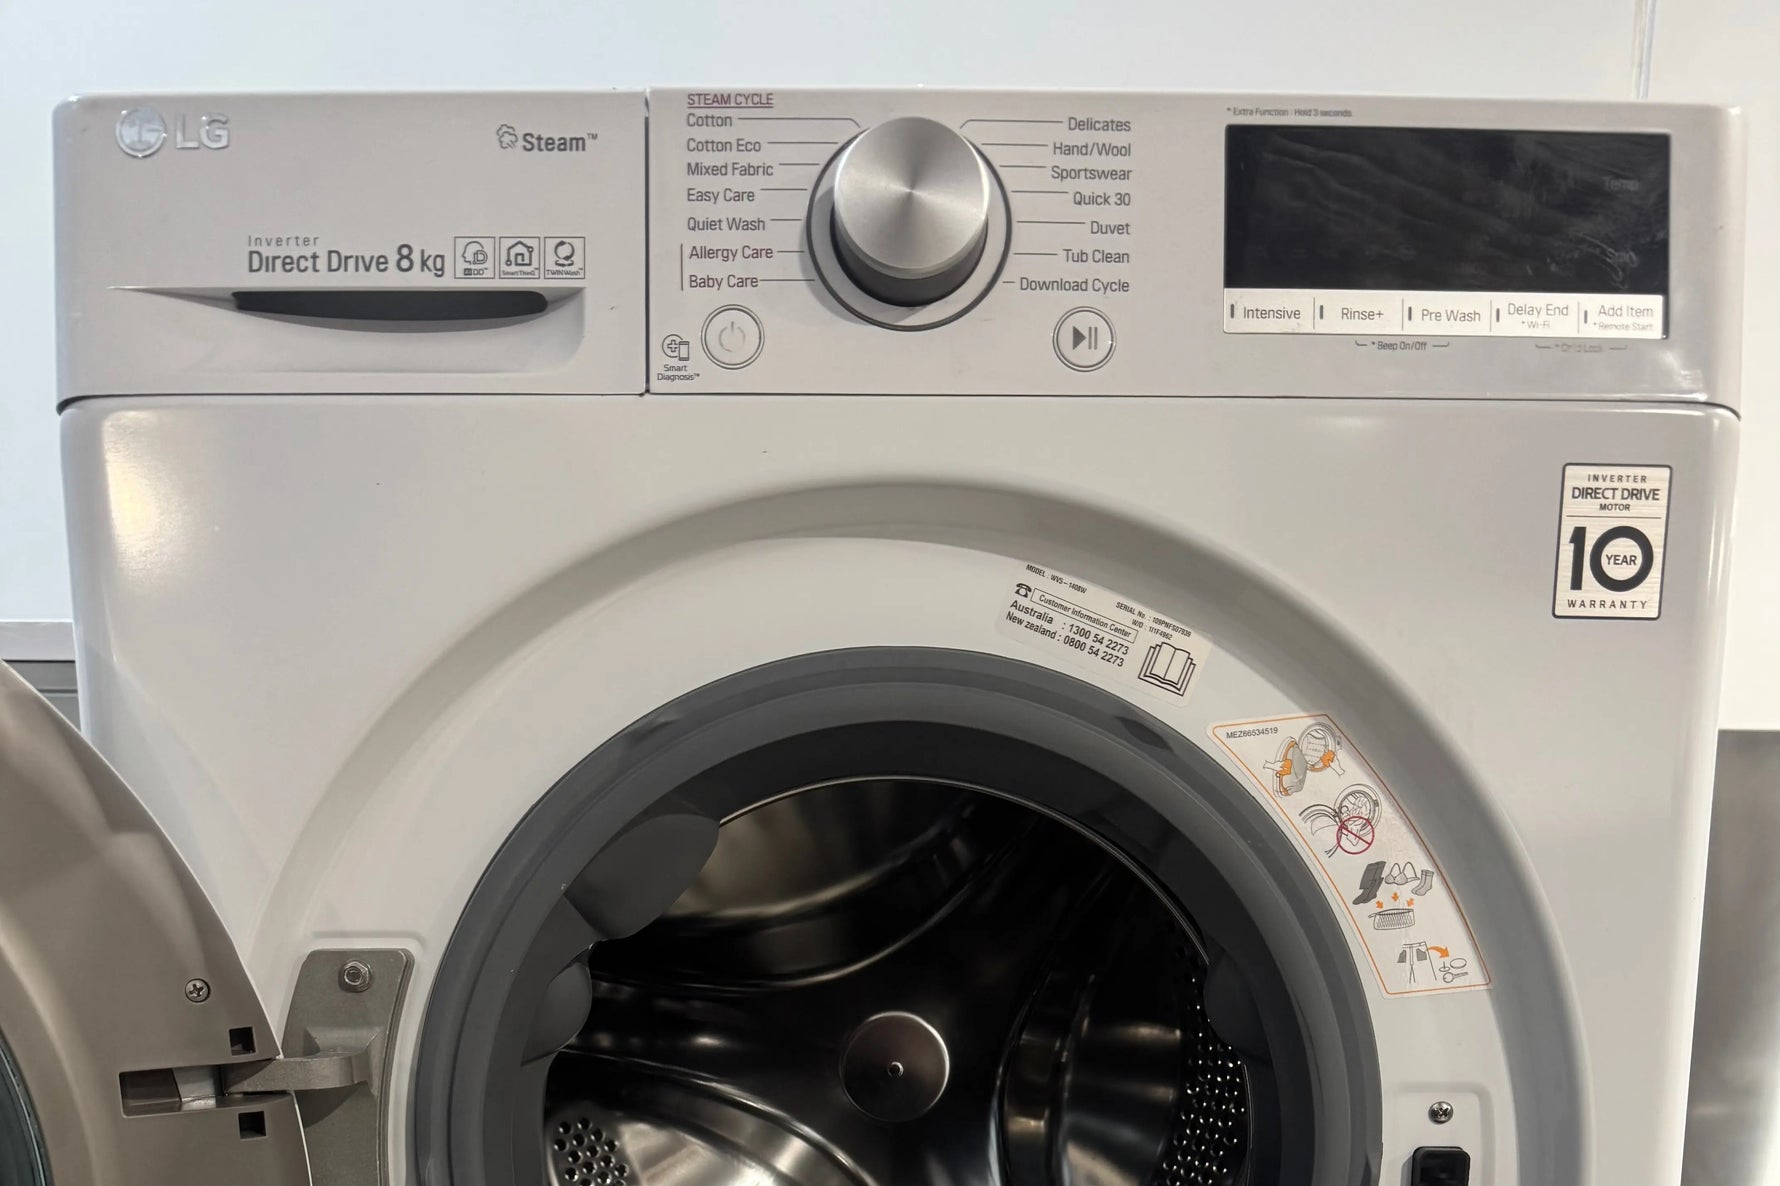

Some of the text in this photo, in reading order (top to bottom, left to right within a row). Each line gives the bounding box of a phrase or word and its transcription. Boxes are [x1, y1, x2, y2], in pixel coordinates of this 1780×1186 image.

[687, 92, 774, 105] STEAM CYCLE
[687, 113, 733, 127] Cotton
[1068, 117, 1132, 132] Delicates
[687, 138, 762, 152] Cotton Eco
[1053, 142, 1132, 157] Hand/Wool
[687, 162, 774, 176] Mixed Fabric
[1051, 165, 1133, 183] Sportswear
[687, 188, 755, 205] Easy Care
[1073, 191, 1132, 206] Quick 30
[687, 217, 766, 232] Quiet Wash
[1090, 220, 1131, 235] Duvet
[248, 235, 320, 247] Inverter
[396, 244, 415, 273] 8
[420, 249, 446, 277] kg
[689, 245, 774, 262] Allergy Care
[1062, 249, 1130, 263] Tub Clean
[689, 274, 759, 291] Baby Care
[1020, 277, 1130, 295] Download Cycle
[1243, 306, 1301, 319] Intensive
[1341, 307, 1384, 320] Rinse+
[1421, 309, 1481, 322] Pre Wash
[1508, 303, 1569, 318] Delay End
[1599, 305, 1653, 318] Add Item
[1599, 322, 1653, 331] Remote Start
[1377, 341, 1427, 351] Beep On/Off
[1587, 474, 1647, 483] INVERTER
[1571, 487, 1660, 501] DIRECT DRIVE
[1599, 503, 1631, 511] MOTOR
[1568, 525, 1654, 593] 10
[1606, 554, 1637, 566] YEAR
[1025, 563, 1046, 578] MODEL
[1115, 601, 1136, 616] SERIAL
[1567, 599, 1648, 609] WARRANTY
[1039, 594, 1132, 638] Customer Information Center
[1010, 600, 1130, 656] Australia 1300 54 2273
[1006, 611, 1125, 668] New zealand 0800 54 2273
[1226, 727, 1279, 739] MEZ66534519
